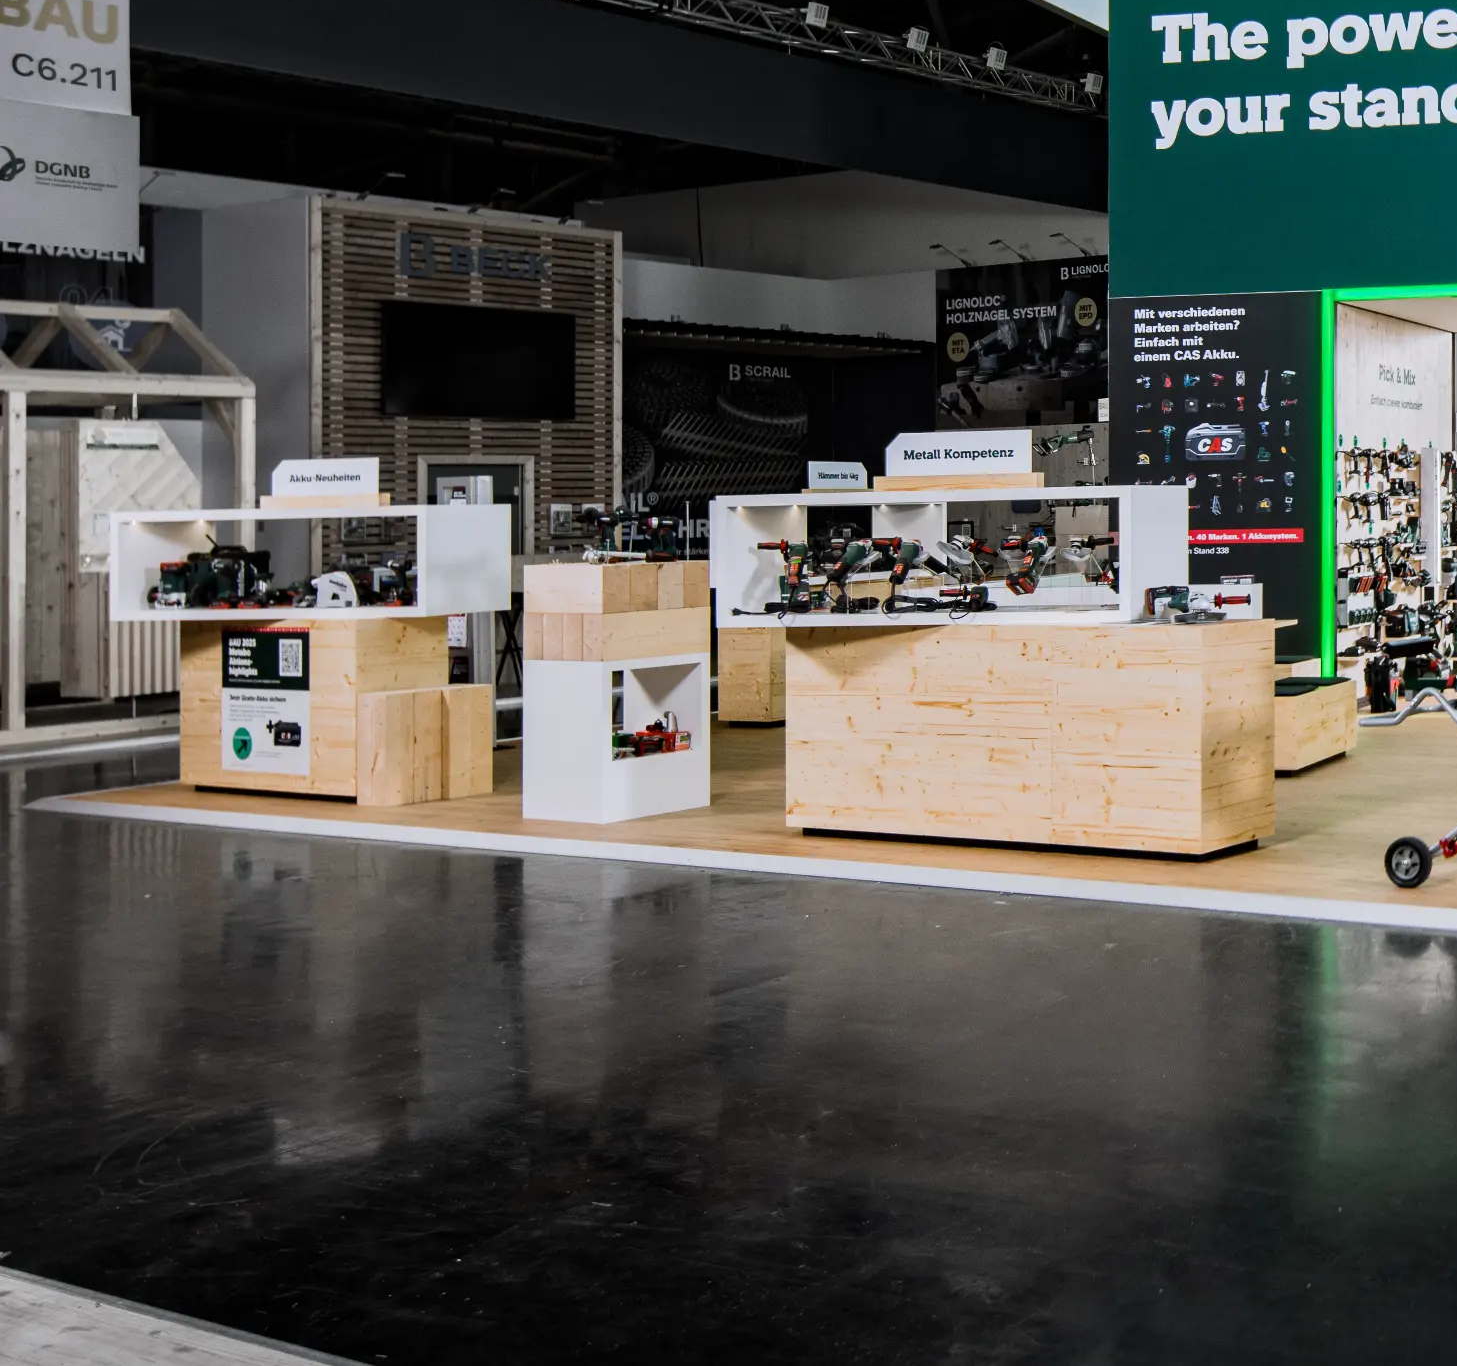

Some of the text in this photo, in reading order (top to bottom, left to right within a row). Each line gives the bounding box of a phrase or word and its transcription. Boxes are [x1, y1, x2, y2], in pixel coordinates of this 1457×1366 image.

[1151, 12, 1269, 64] The
[11, 52, 117, 92] C6.211
[1151, 94, 1291, 150] your
[35, 160, 91, 179] DGNB
[449, 245, 553, 281] BECK
[946, 305, 1057, 324] HOLZNAGEL SYSTEM
[1134, 306, 1246, 320] Mit verschiedenen
[1134, 320, 1241, 334] Marken arbeiten?
[1134, 336, 1204, 348] Einfach mit
[1133, 349, 1240, 362] einem CAS Akku.
[744, 365, 791, 378] SCRAIL
[1379, 364, 1394, 383] Pick
[1403, 369, 1416, 386] Mix
[1197, 437, 1233, 453] CAS
[903, 448, 1015, 463] Metall Kompetenz
[289, 473, 361, 483] Akku-Neuheiten
[1247, 532, 1299, 541] Akkusystem.
[1193, 547, 1215, 555] Stand
[1215, 546, 1229, 554] 338
